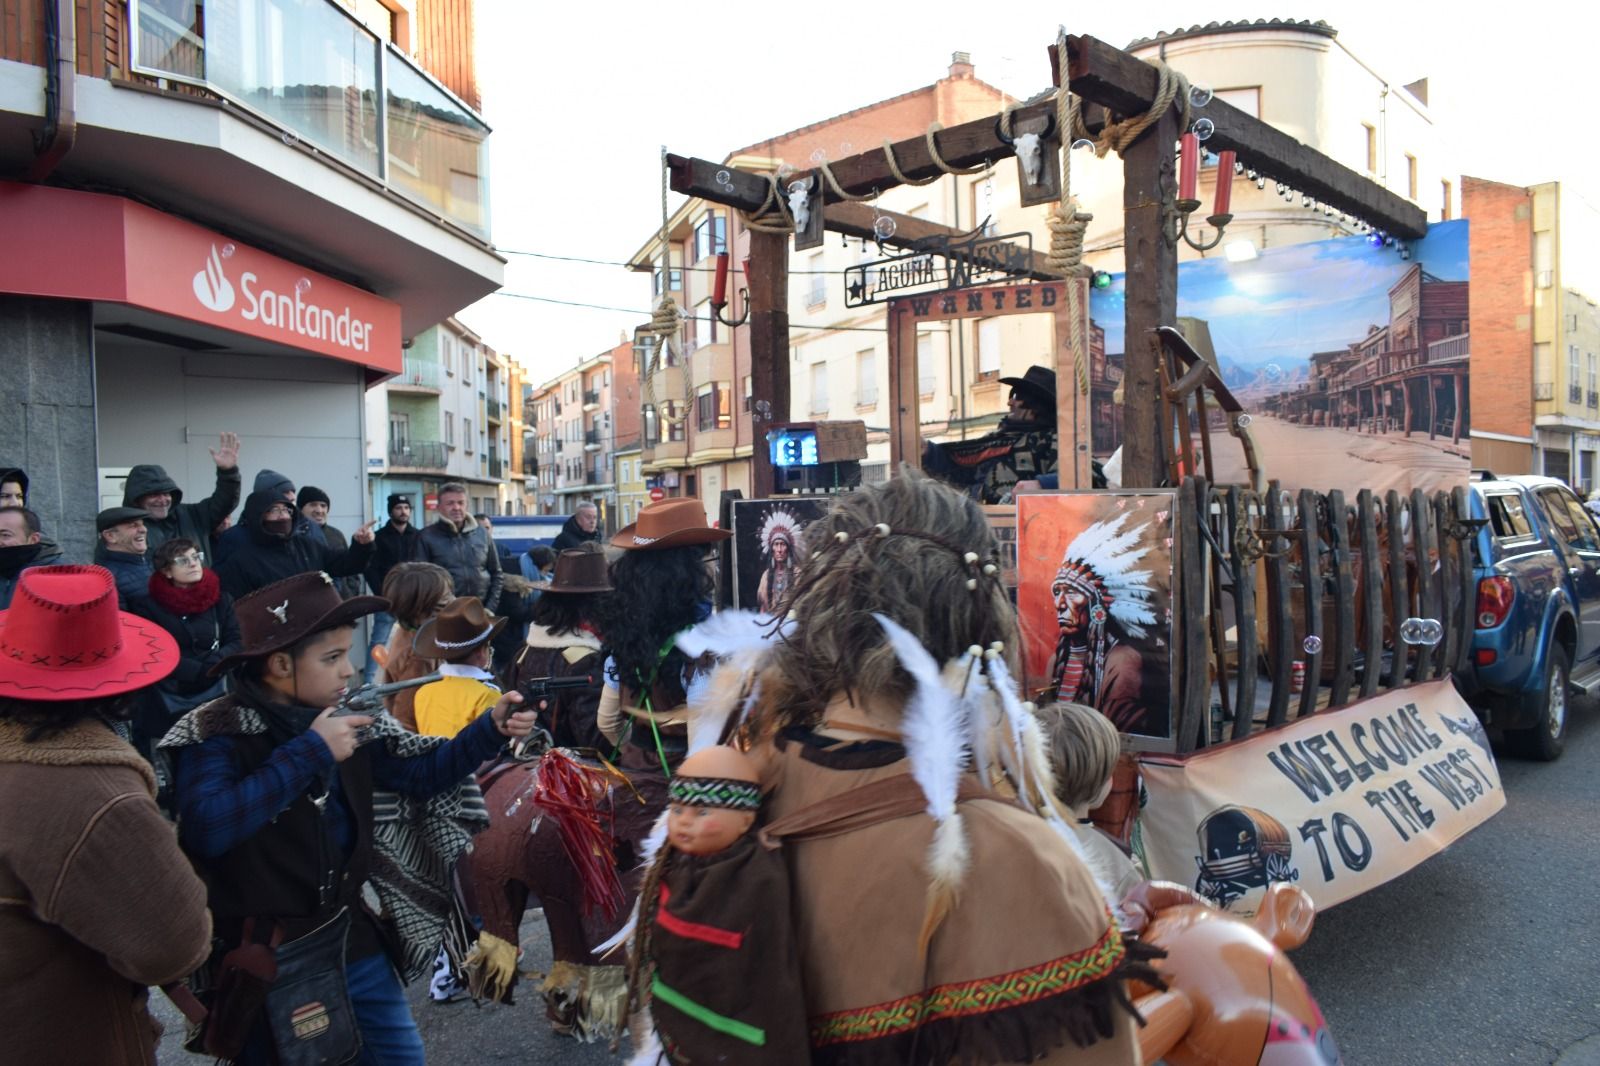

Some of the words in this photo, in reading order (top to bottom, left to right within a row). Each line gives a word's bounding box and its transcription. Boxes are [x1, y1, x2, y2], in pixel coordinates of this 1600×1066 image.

[911, 287, 1057, 317] WANTED
[945, 240, 1016, 289] WEST
[241, 272, 373, 352] Santander
[1266, 703, 1443, 803] WELCOME
[1297, 812, 1373, 882] TO
[1362, 779, 1436, 842] THE
[1418, 748, 1493, 811] WEST
